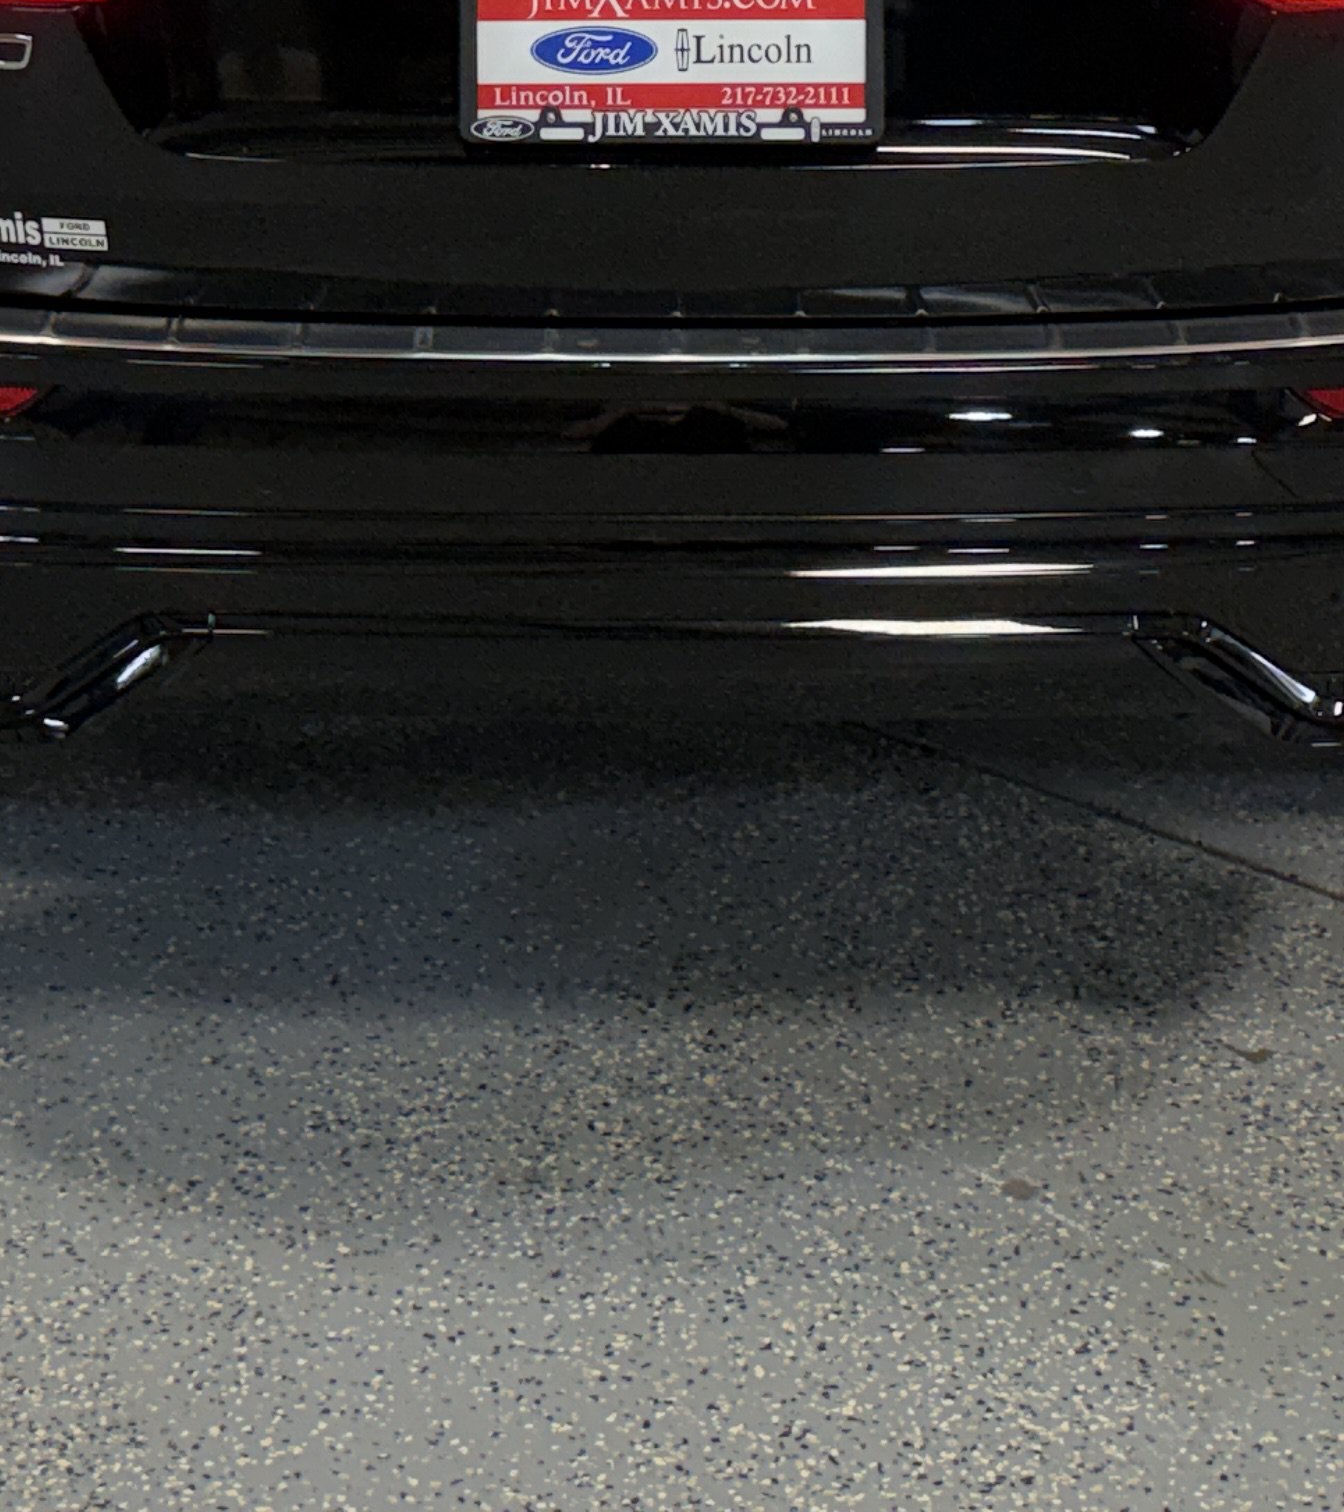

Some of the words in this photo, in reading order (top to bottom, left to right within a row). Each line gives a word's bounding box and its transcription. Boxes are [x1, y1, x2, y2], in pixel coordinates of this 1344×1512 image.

[557, 32, 632, 65] Ford
[692, 34, 812, 64] Lincoln
[493, 87, 596, 107] Lincoln,
[606, 87, 631, 105] IL
[721, 88, 850, 105] 217-732-2111
[587, 111, 644, 141] JIM
[653, 111, 757, 137] XAMIS
[49, 254, 64, 266] IL
